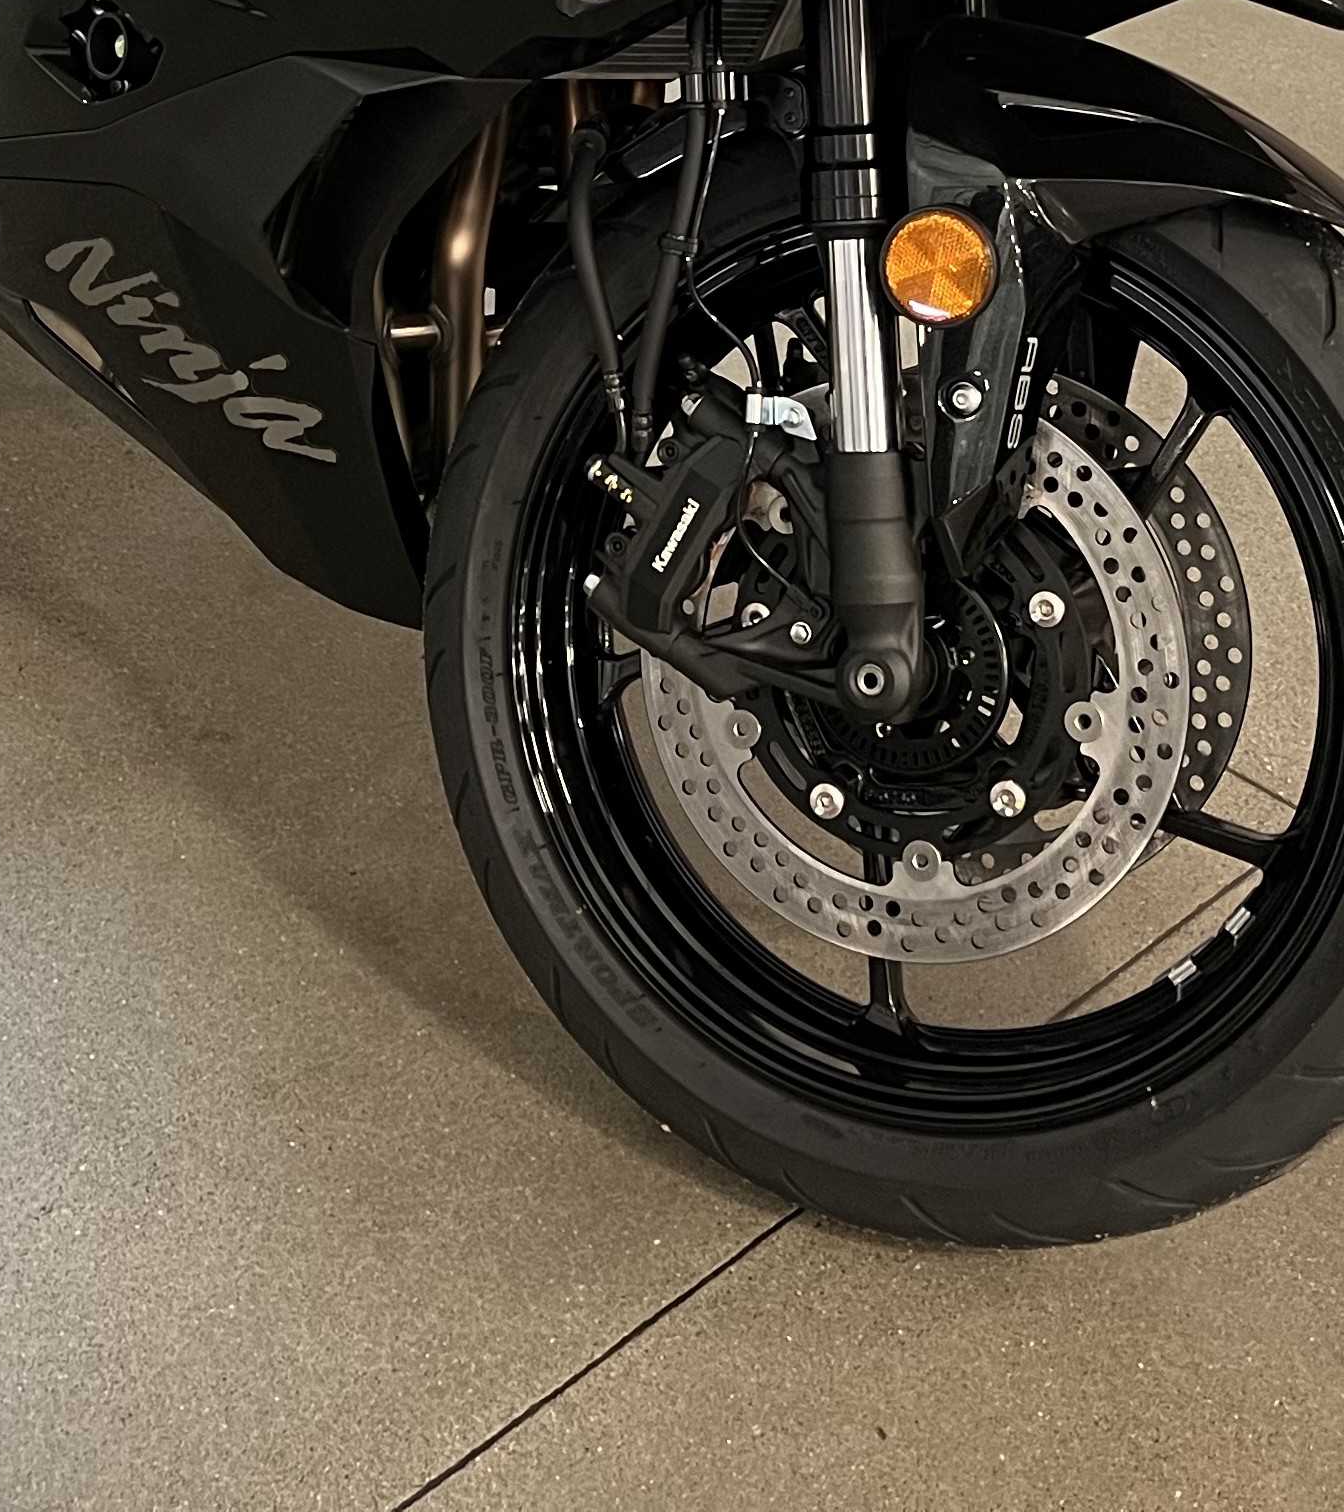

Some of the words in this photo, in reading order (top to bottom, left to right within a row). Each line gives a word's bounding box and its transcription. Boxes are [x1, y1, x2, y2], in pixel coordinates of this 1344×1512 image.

[45, 237, 338, 464] Ninja
[1007, 336, 1039, 449] ABS
[651, 497, 700, 573] Kawasaki
[480, 646, 519, 805] GPR-300F
